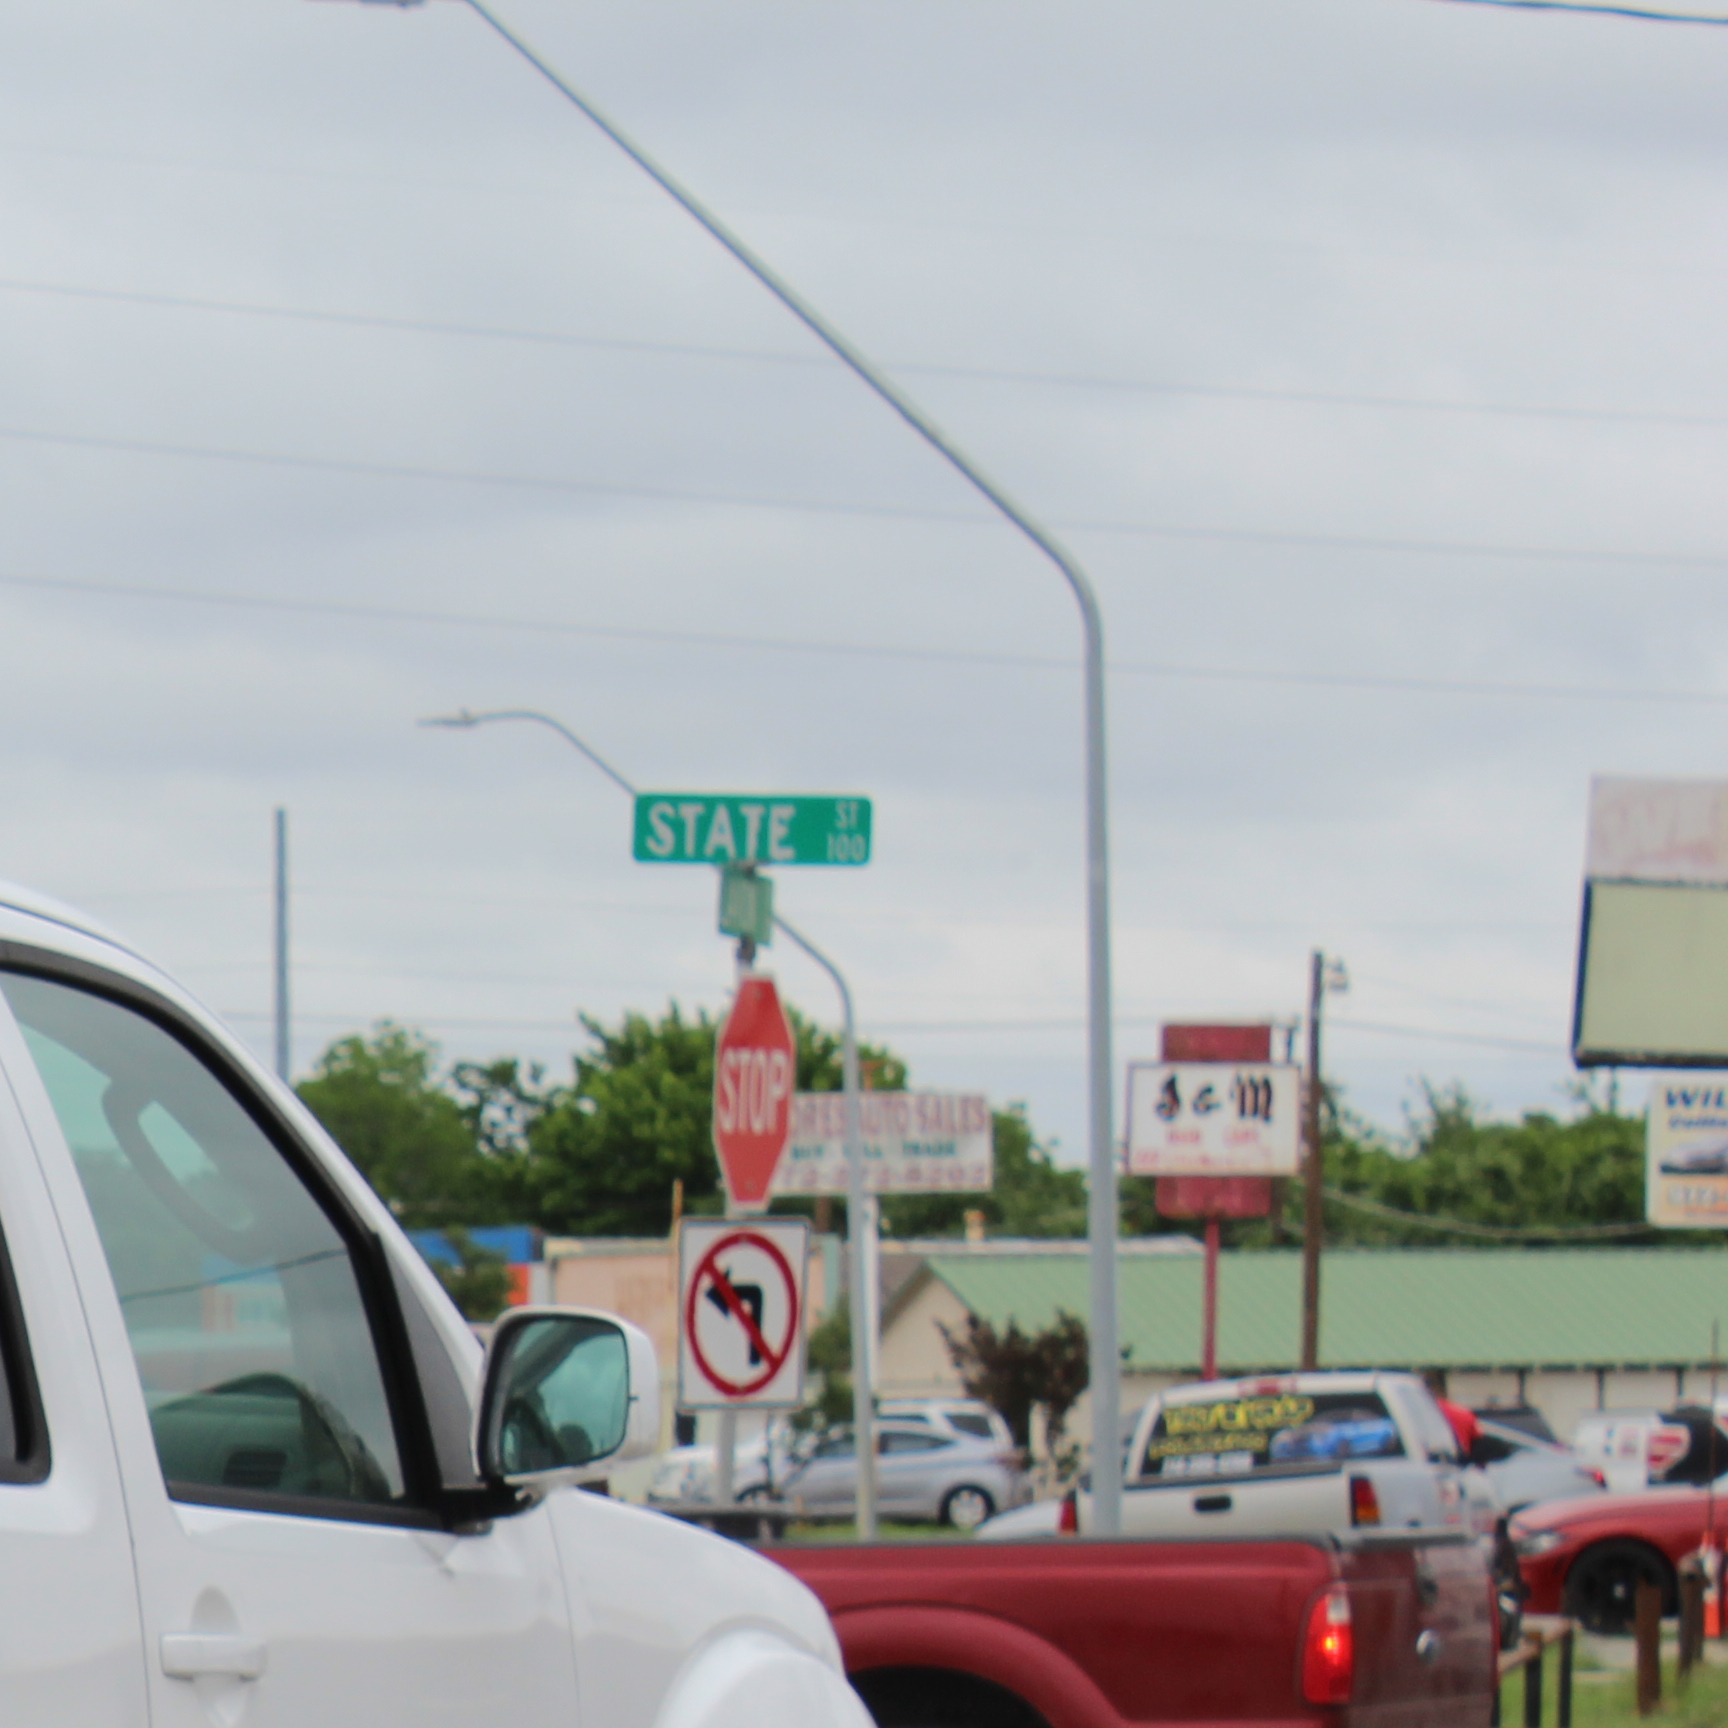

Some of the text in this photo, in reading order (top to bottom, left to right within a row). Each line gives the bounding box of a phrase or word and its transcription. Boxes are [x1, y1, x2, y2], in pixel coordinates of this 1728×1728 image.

[647, 802, 795, 861] STATE
[835, 801, 859, 829] ST
[827, 833, 866, 863] 100
[718, 1047, 788, 1135] STOP
[916, 1094, 986, 1135] SALES
